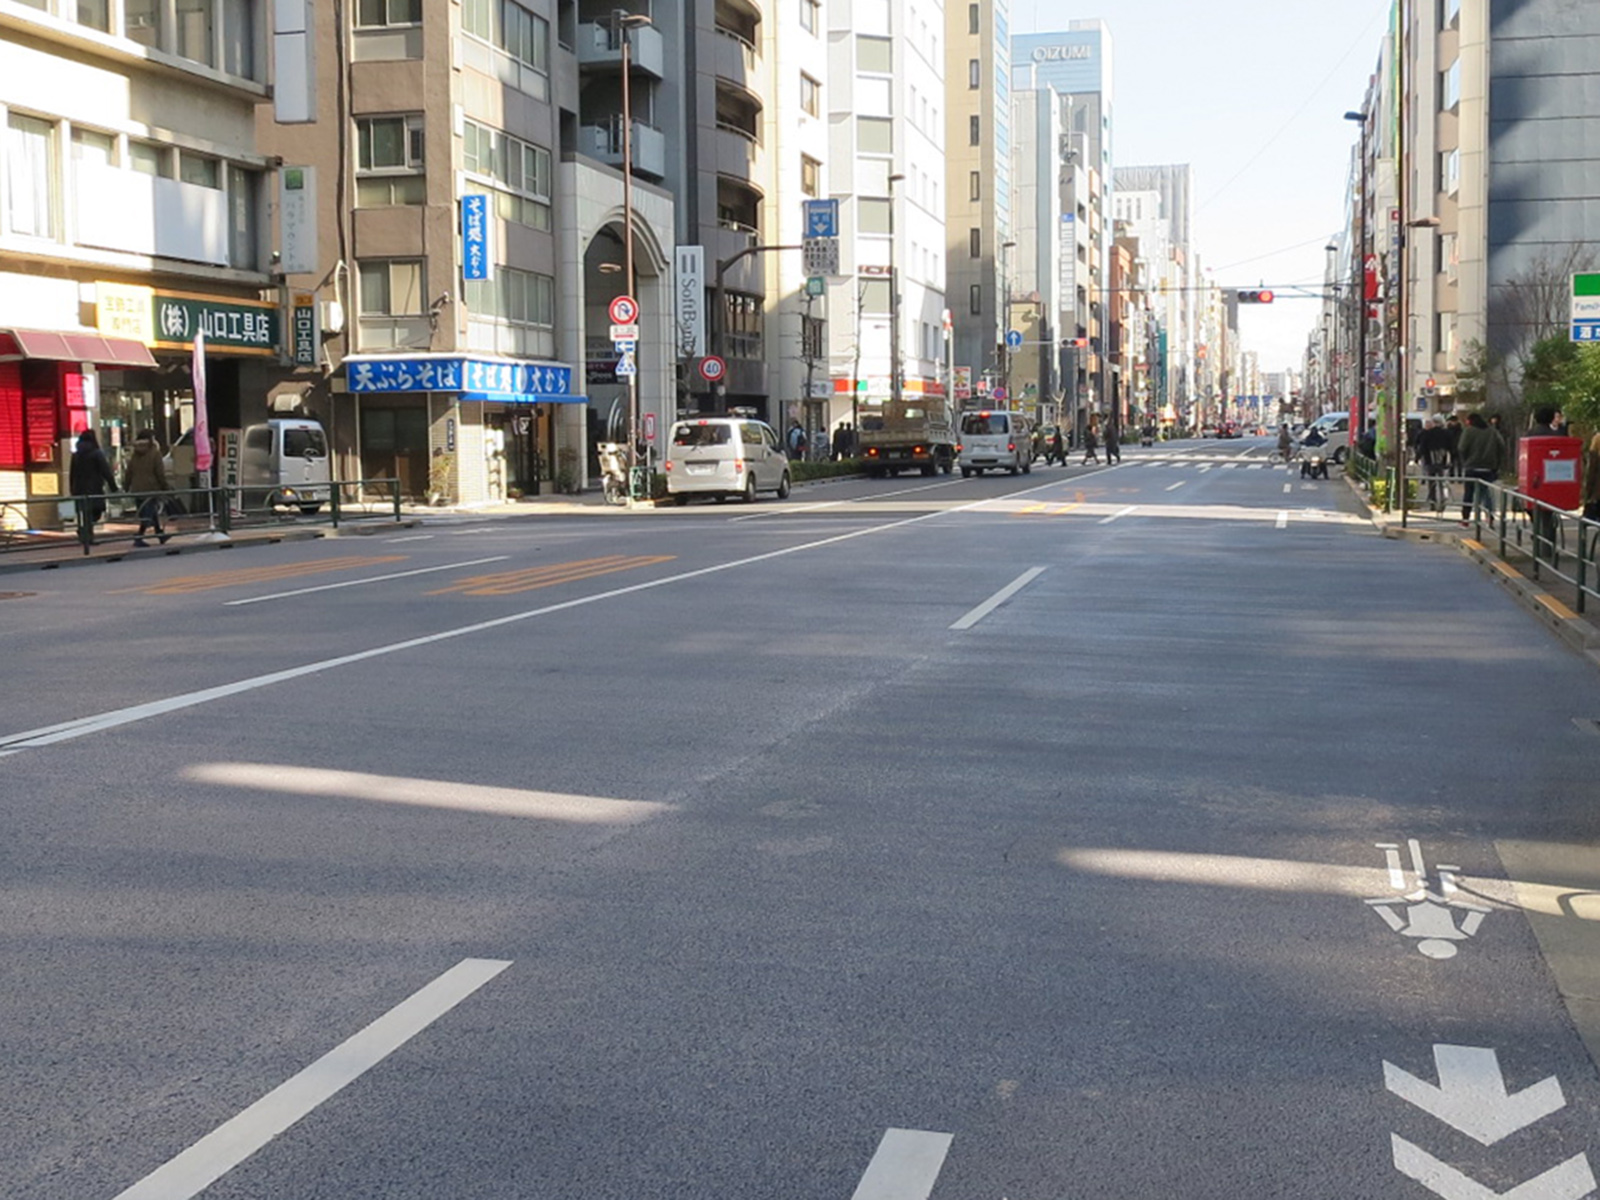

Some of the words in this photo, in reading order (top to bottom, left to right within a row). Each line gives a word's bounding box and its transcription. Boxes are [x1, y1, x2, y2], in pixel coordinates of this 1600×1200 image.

[198, 308, 270, 342] 山口工具店
[297, 308, 312, 361] 山口工具店
[705, 362, 720, 375] 40
